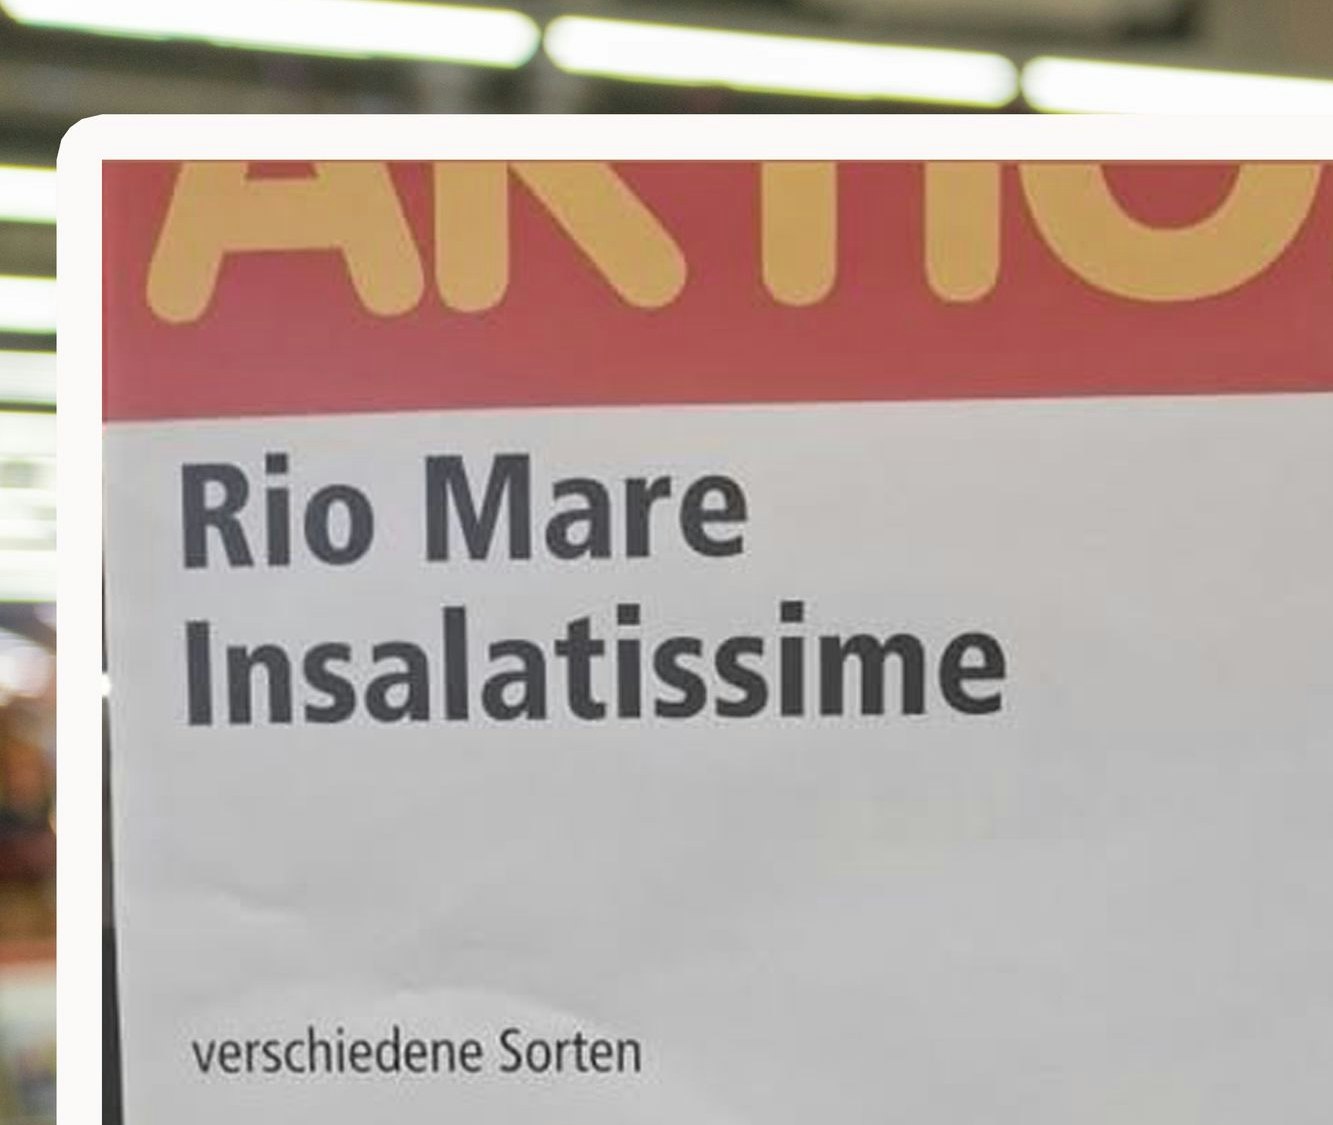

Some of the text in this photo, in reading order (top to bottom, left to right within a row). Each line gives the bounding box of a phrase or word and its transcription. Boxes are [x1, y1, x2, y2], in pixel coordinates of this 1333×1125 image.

[182, 452, 749, 569] Rio Mare
[185, 600, 1008, 726] Insalatissime
[191, 1025, 643, 1075] verschiedene Sorten
